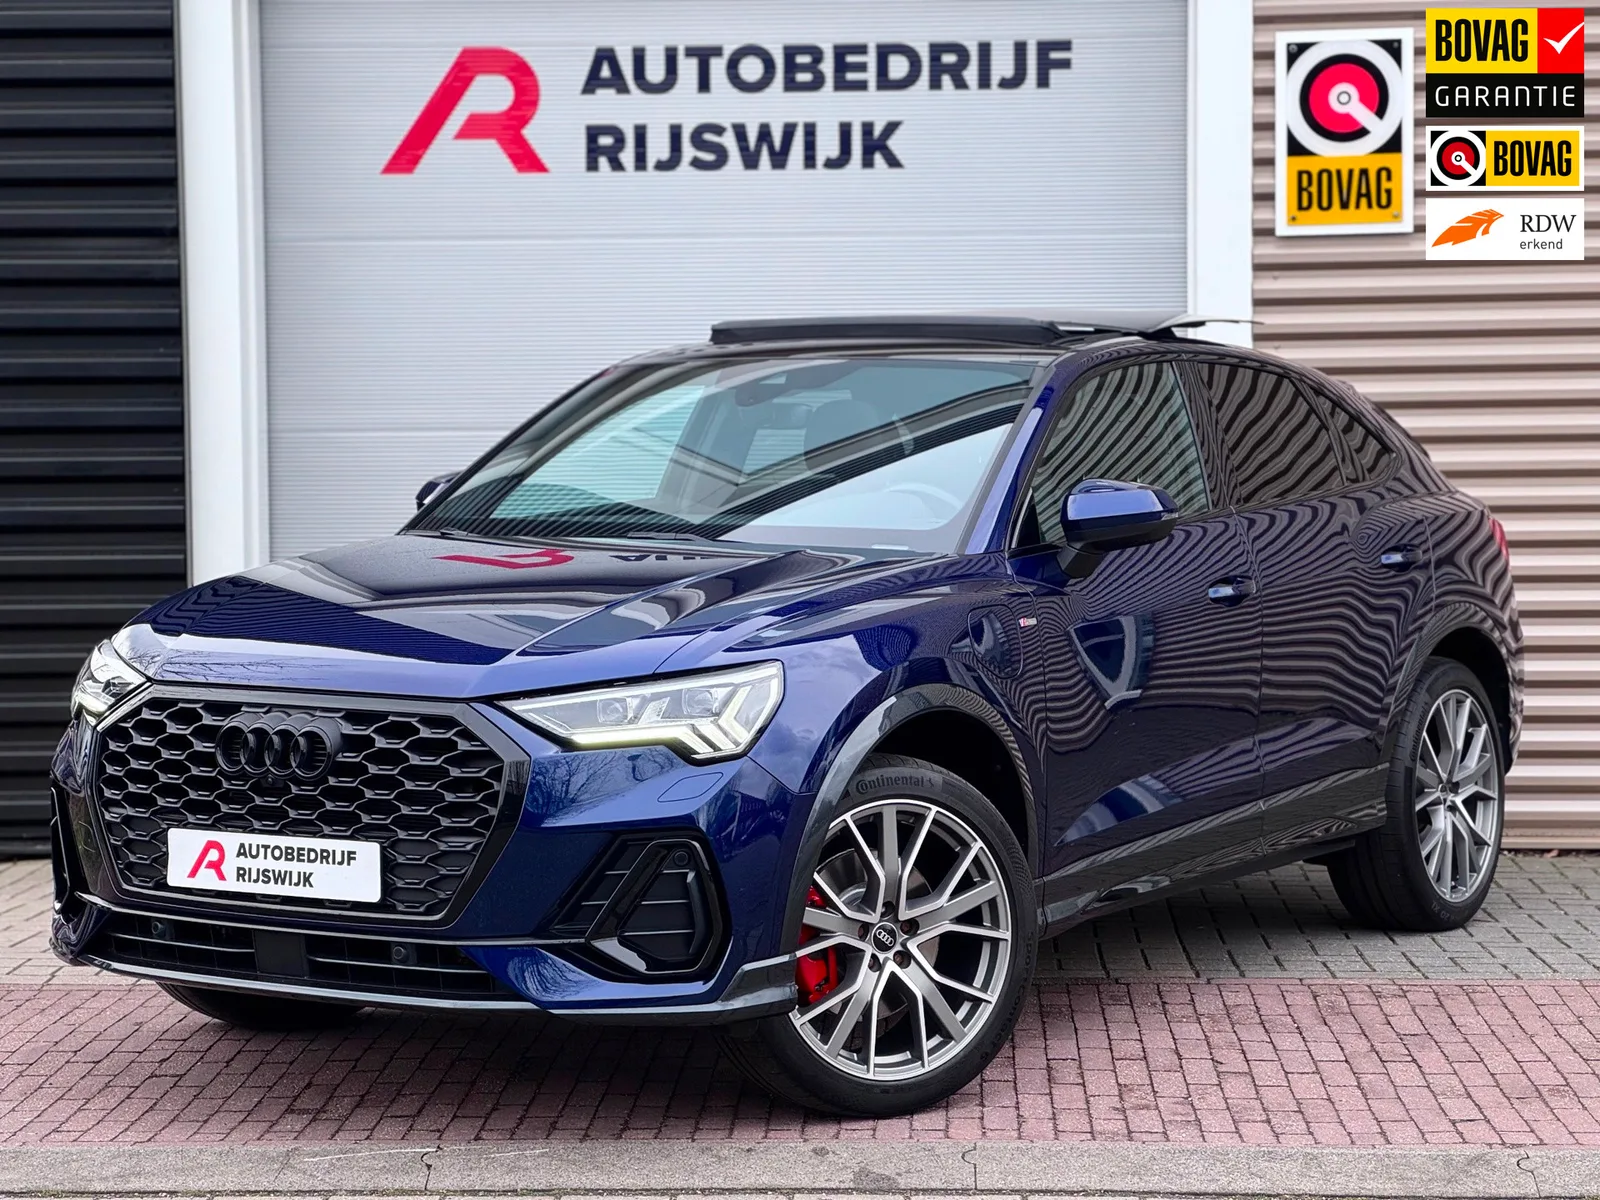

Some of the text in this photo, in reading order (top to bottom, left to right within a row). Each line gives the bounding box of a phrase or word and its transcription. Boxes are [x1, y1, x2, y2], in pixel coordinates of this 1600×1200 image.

[581, 40, 1073, 95] AUTOBEDRIJF
[585, 120, 904, 172] RIJSWIJK
[1297, 167, 1393, 212] BOVAG
[855, 774, 925, 795] Continental
[235, 842, 357, 866] AUTOBEDRIJF
[235, 866, 314, 888] RIJSWIJK
